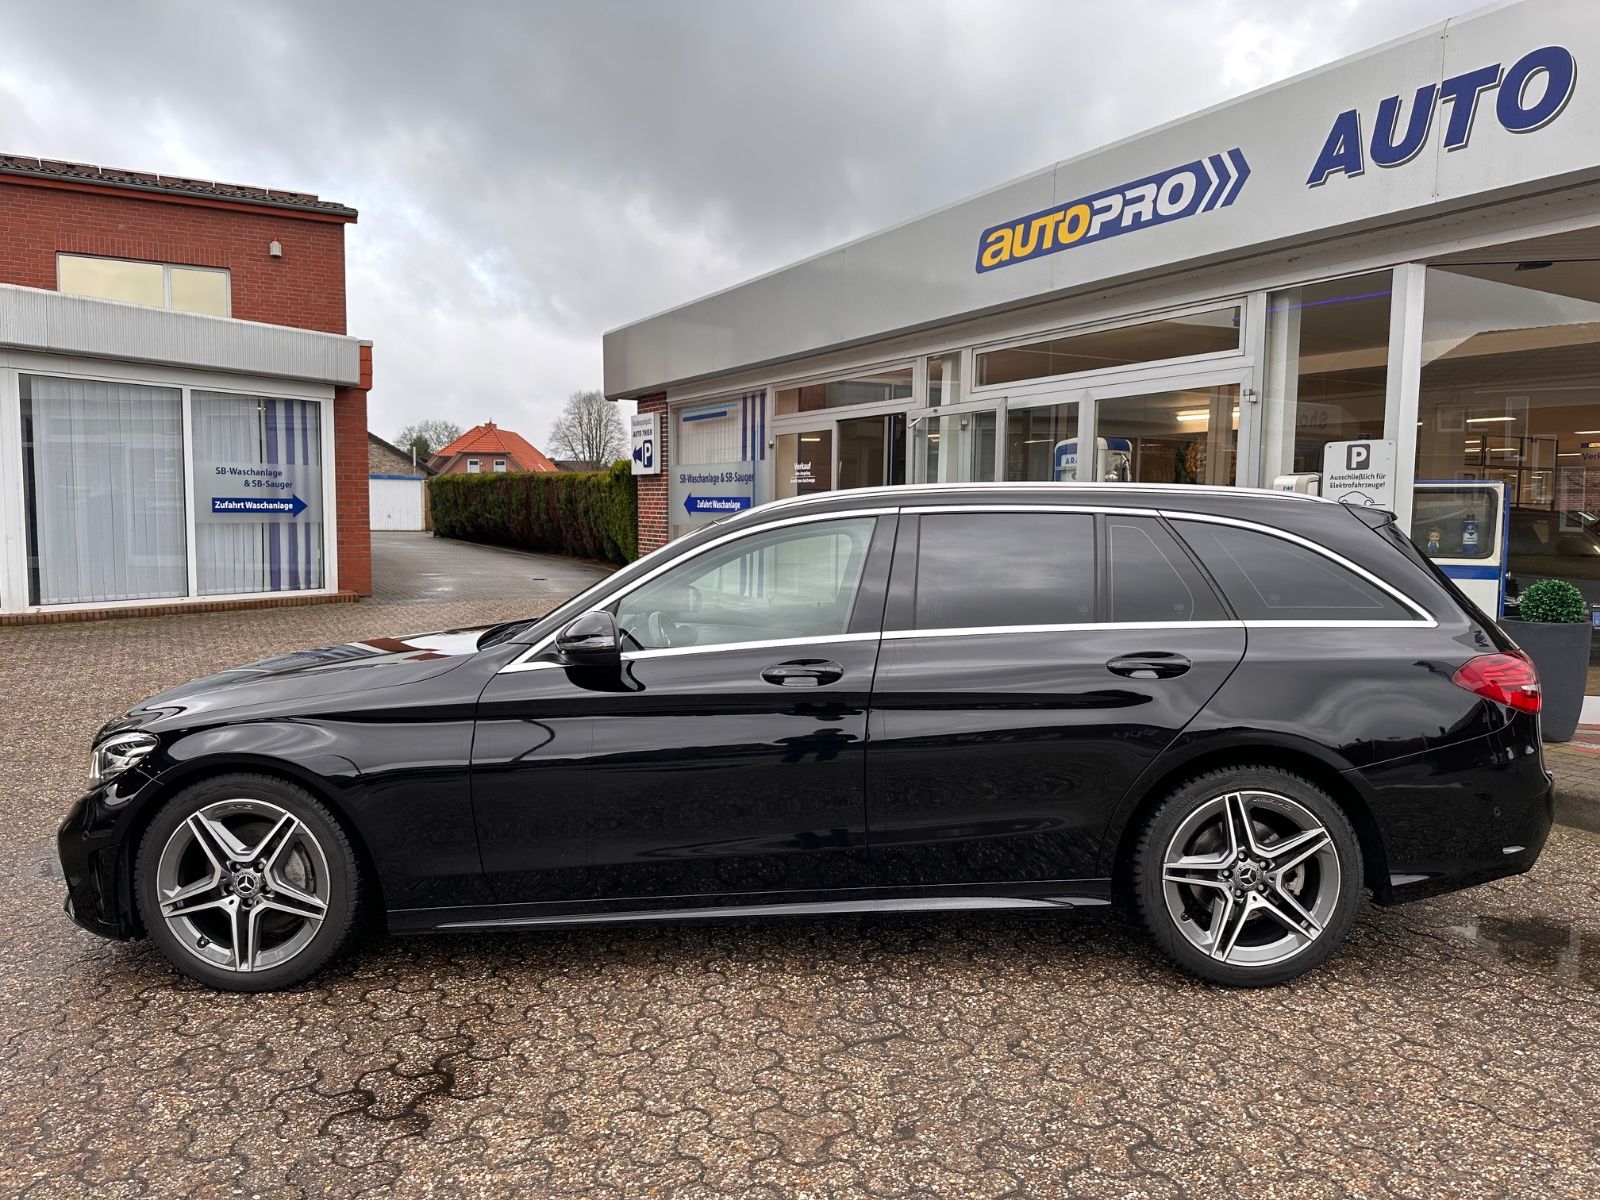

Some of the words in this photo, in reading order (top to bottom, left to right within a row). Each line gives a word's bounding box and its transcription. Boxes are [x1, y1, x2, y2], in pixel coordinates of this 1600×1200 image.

[1306, 45, 1577, 188] AUTO
[215, 466, 283, 478] SB-Waschanlage
[1330, 473, 1375, 481] Ausschließlich
[1376, 472, 1387, 480] für
[244, 479, 250, 487] &
[252, 479, 293, 490] SB-Sauger
[680, 473, 720, 486] SB-Waschanlage
[720, 472, 725, 483] &
[725, 471, 755, 484] SB-Sauger
[215, 501, 244, 509] Zufahrt
[245, 501, 293, 511] Waschanlage
[697, 499, 712, 508] Zufahrt
[712, 499, 741, 511] Waschanlage
